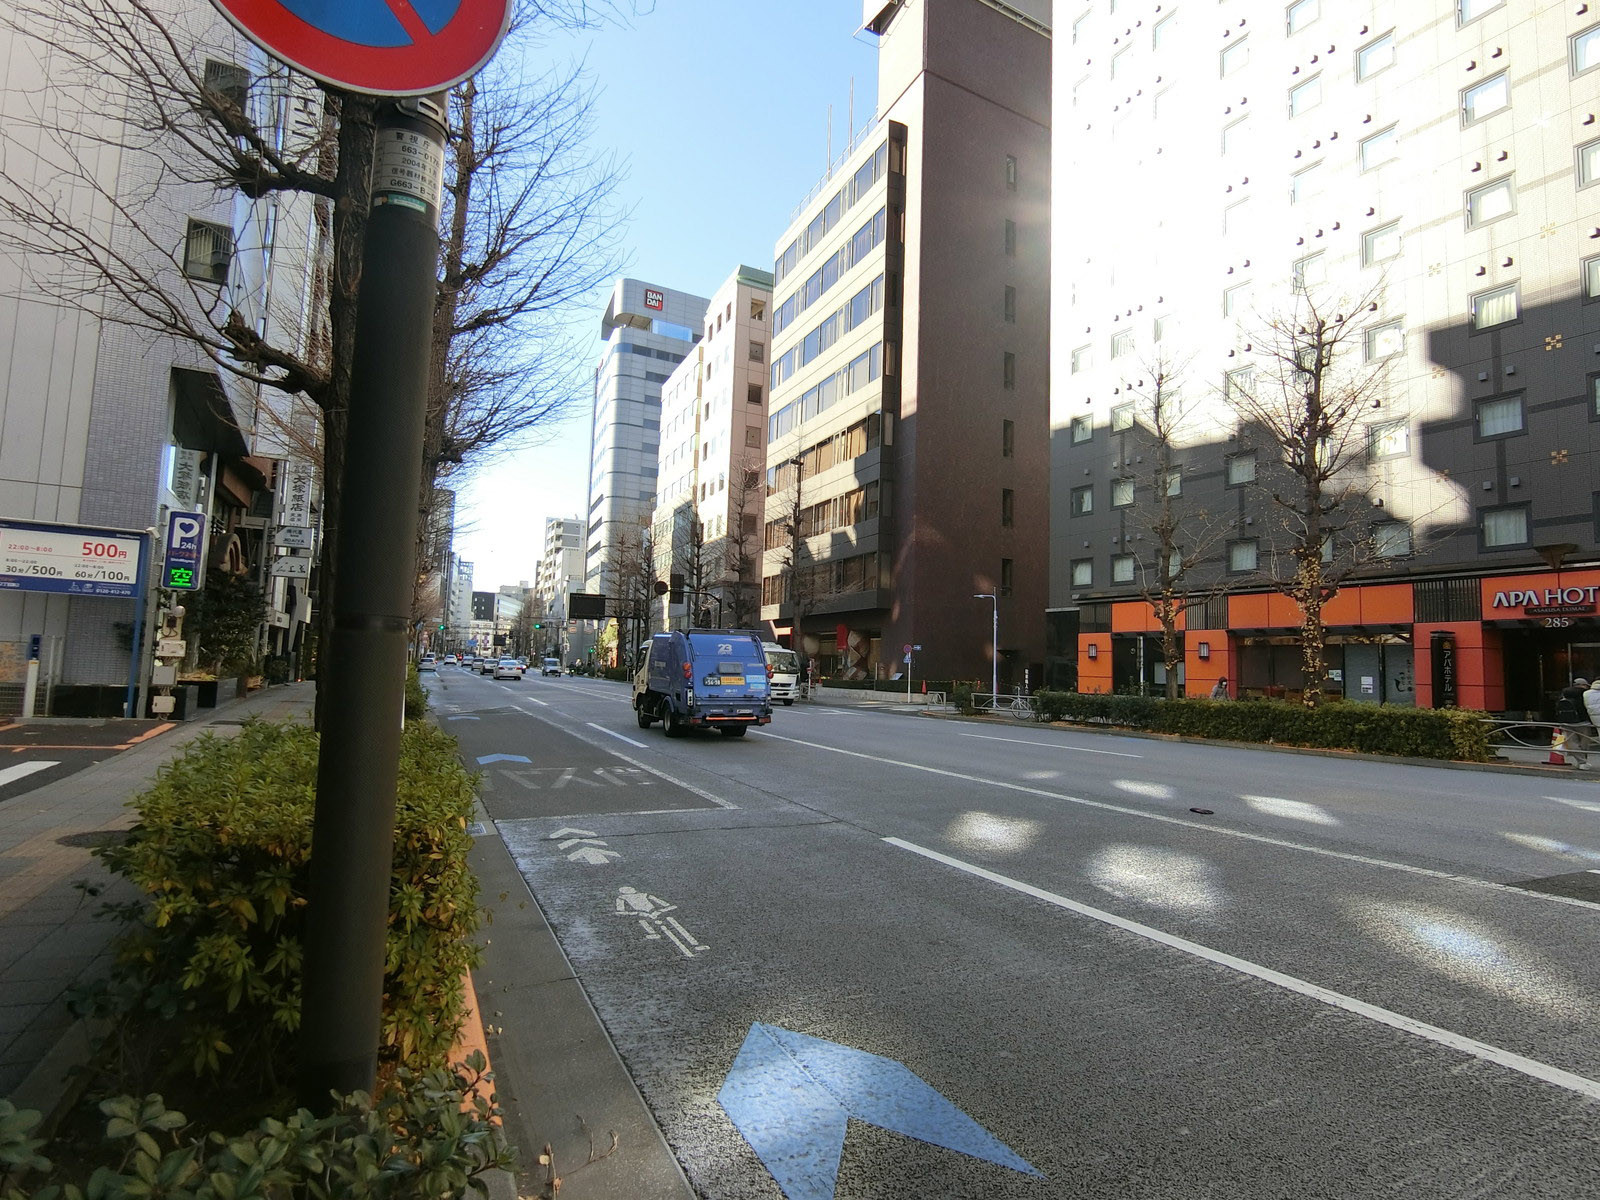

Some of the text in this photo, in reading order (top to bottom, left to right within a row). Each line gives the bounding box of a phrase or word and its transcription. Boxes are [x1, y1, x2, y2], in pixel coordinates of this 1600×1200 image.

[646, 298, 659, 307] DAI
[647, 291, 662, 301] BAN
[290, 474, 306, 512] 大塚紙店
[82, 541, 127, 559] 500円
[181, 542, 197, 550] 24h
[169, 568, 193, 587] 空
[1492, 590, 1540, 608] APA
[1544, 617, 1569, 628] 285
[1443, 650, 1453, 692] アパホテル
